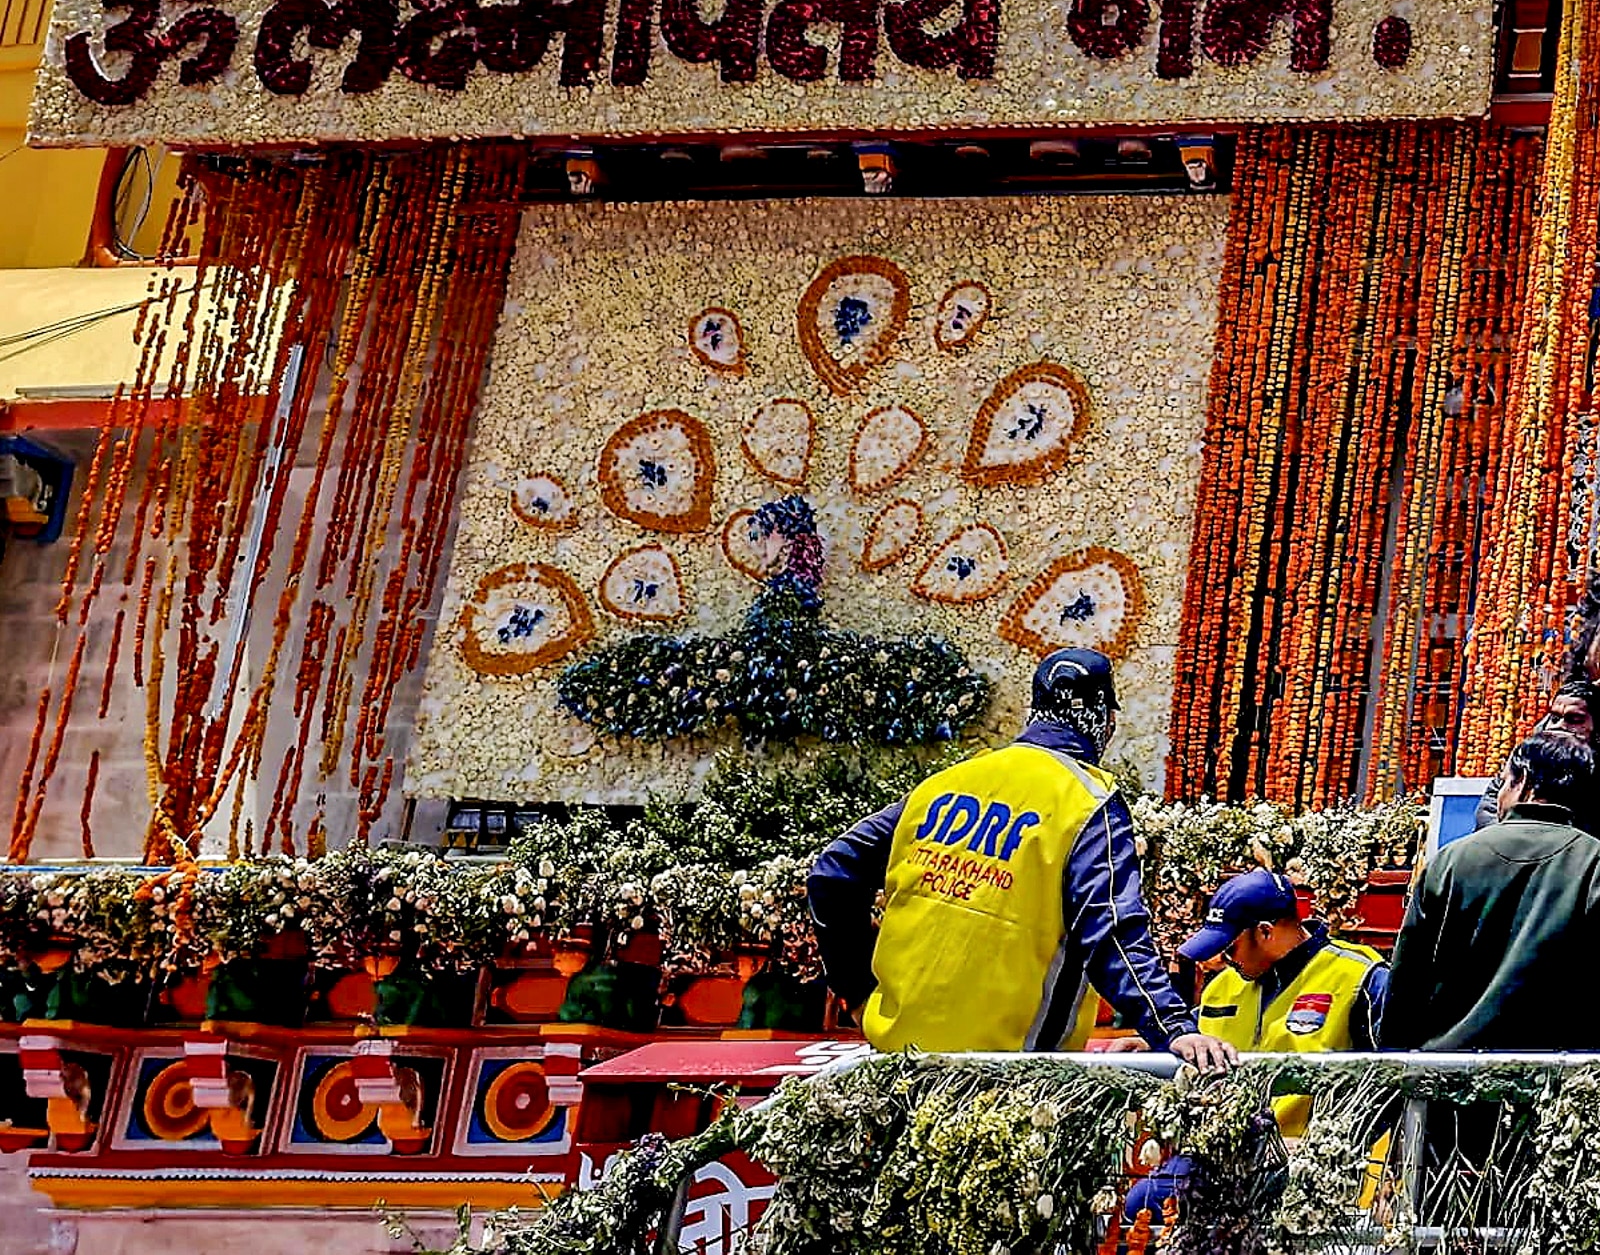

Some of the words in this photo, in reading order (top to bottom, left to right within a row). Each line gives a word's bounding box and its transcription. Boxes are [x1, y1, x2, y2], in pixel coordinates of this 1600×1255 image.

[916, 793, 1041, 862] SDRF
[911, 847, 1014, 890] TTARAKHAND
[921, 871, 977, 901] POLICE
